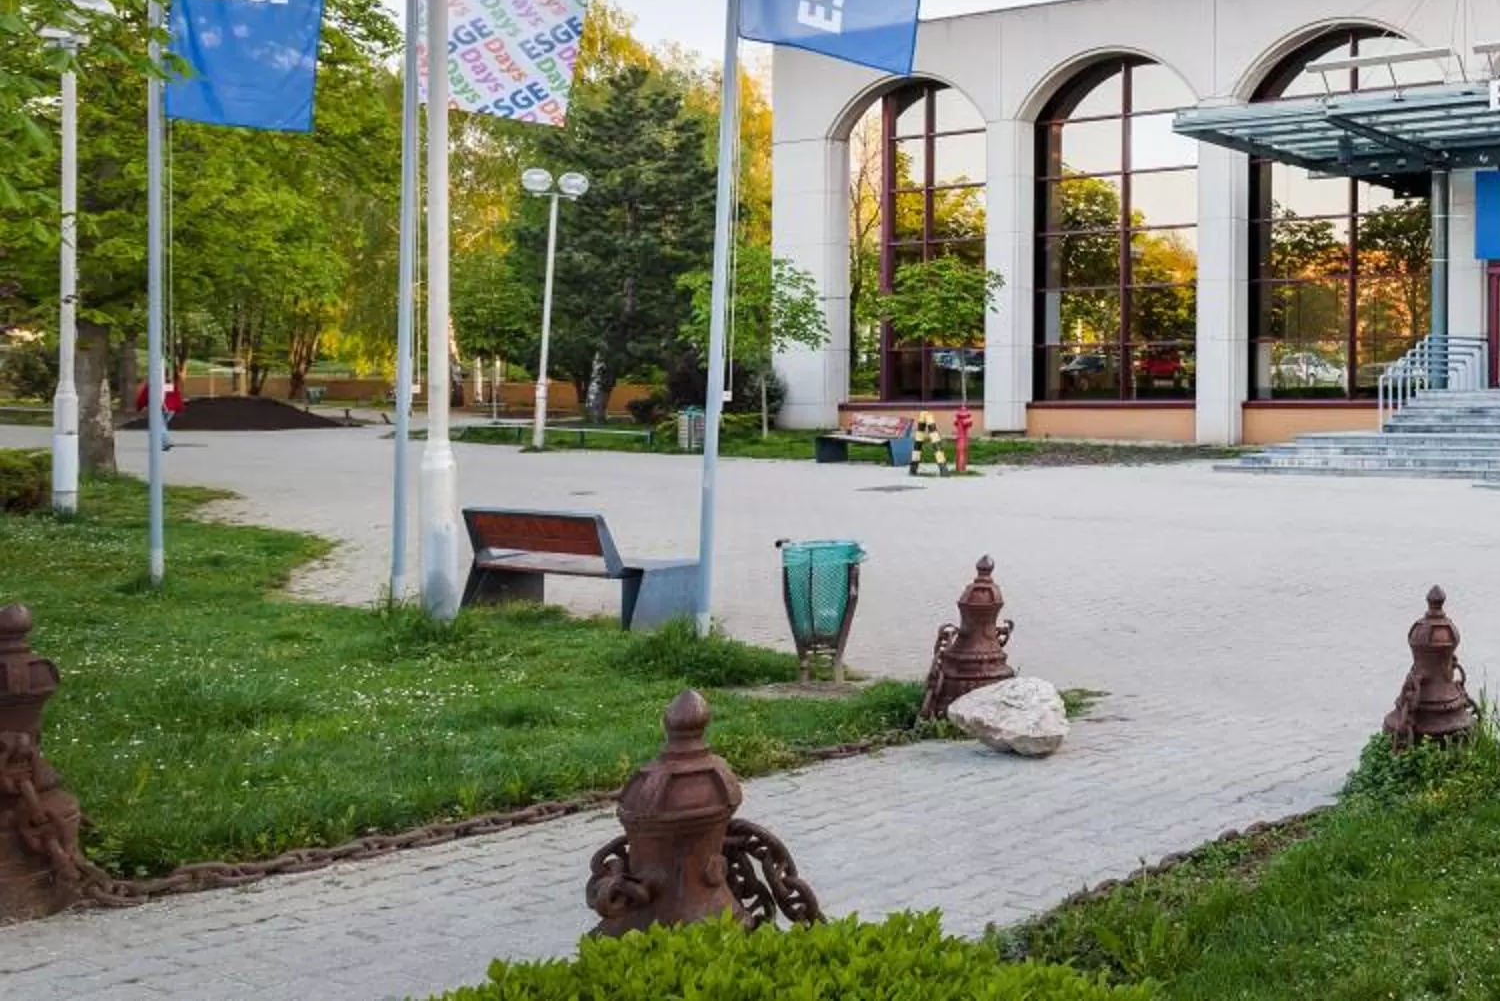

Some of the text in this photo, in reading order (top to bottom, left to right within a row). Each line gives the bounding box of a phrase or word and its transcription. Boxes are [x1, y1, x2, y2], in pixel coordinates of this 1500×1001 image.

[448, 17, 495, 54] GE
[518, 16, 583, 61] ESGE
[460, 47, 504, 93] Days
[484, 37, 527, 82] Days
[536, 57, 571, 97] Day
